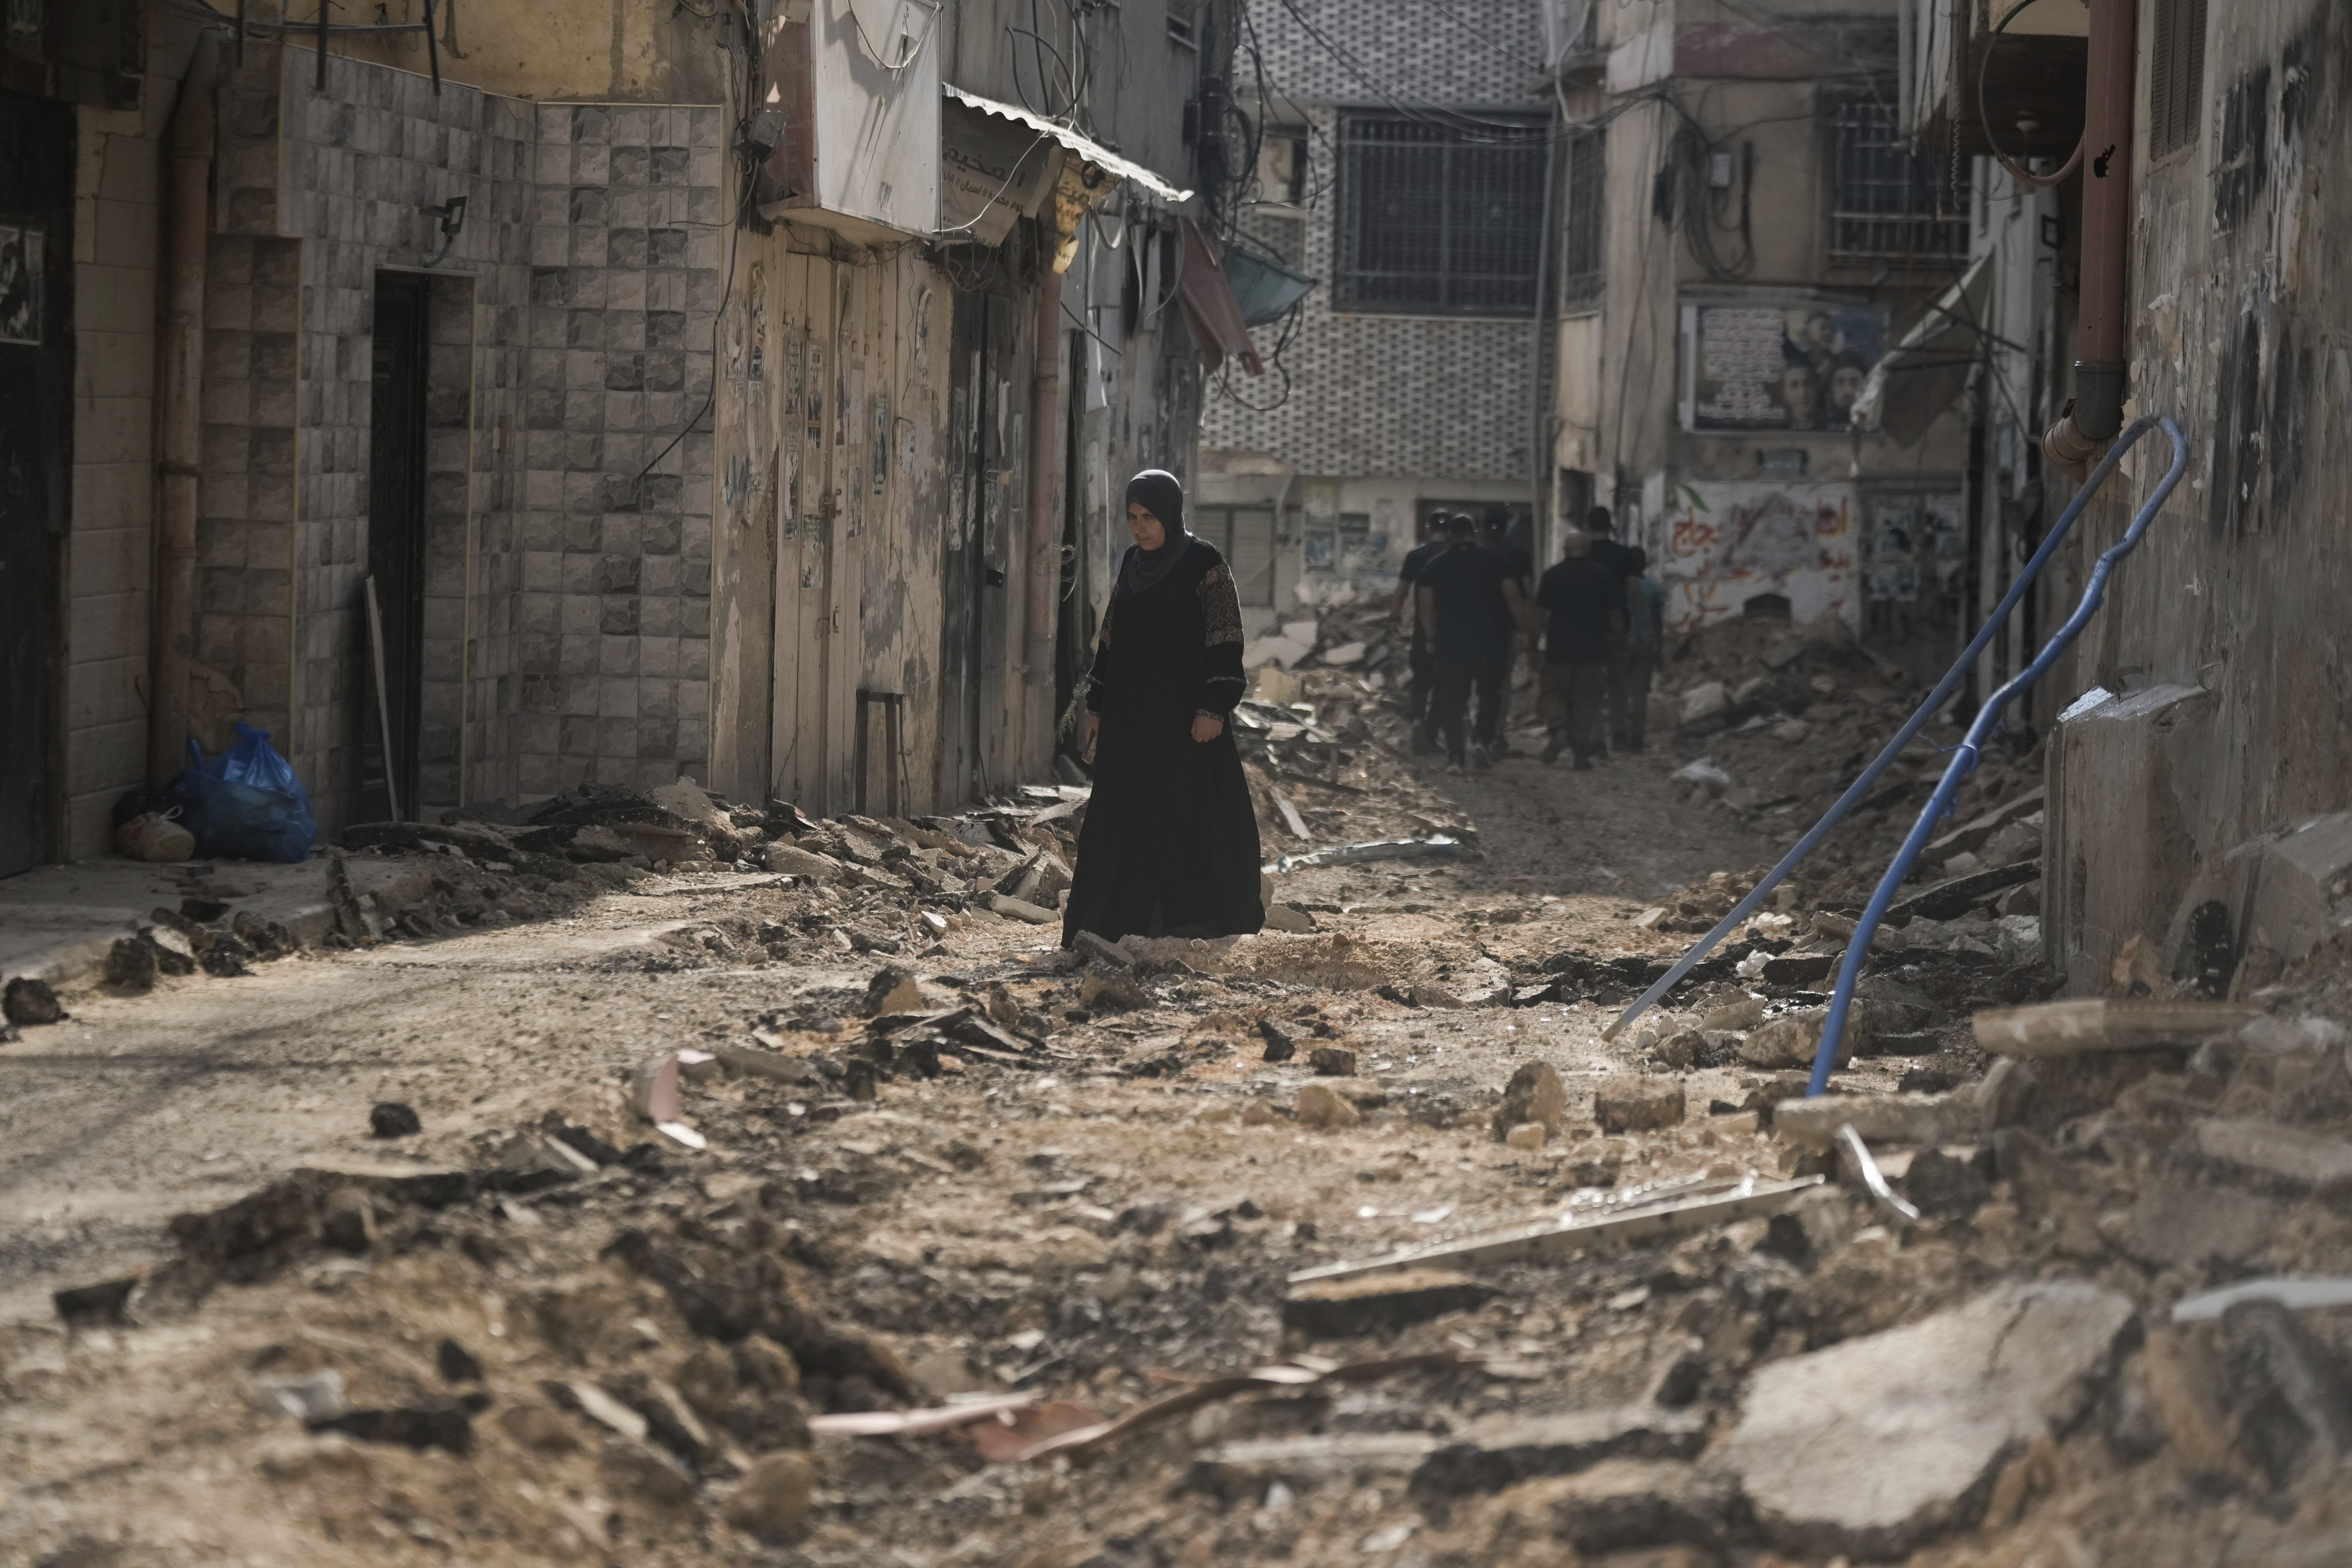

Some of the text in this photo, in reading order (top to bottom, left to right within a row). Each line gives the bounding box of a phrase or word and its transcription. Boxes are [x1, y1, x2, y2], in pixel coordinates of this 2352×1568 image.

[942, 147, 1027, 189] المخيم
[960, 179, 983, 196] اسماك
[1009, 201, 1024, 214] حوم
